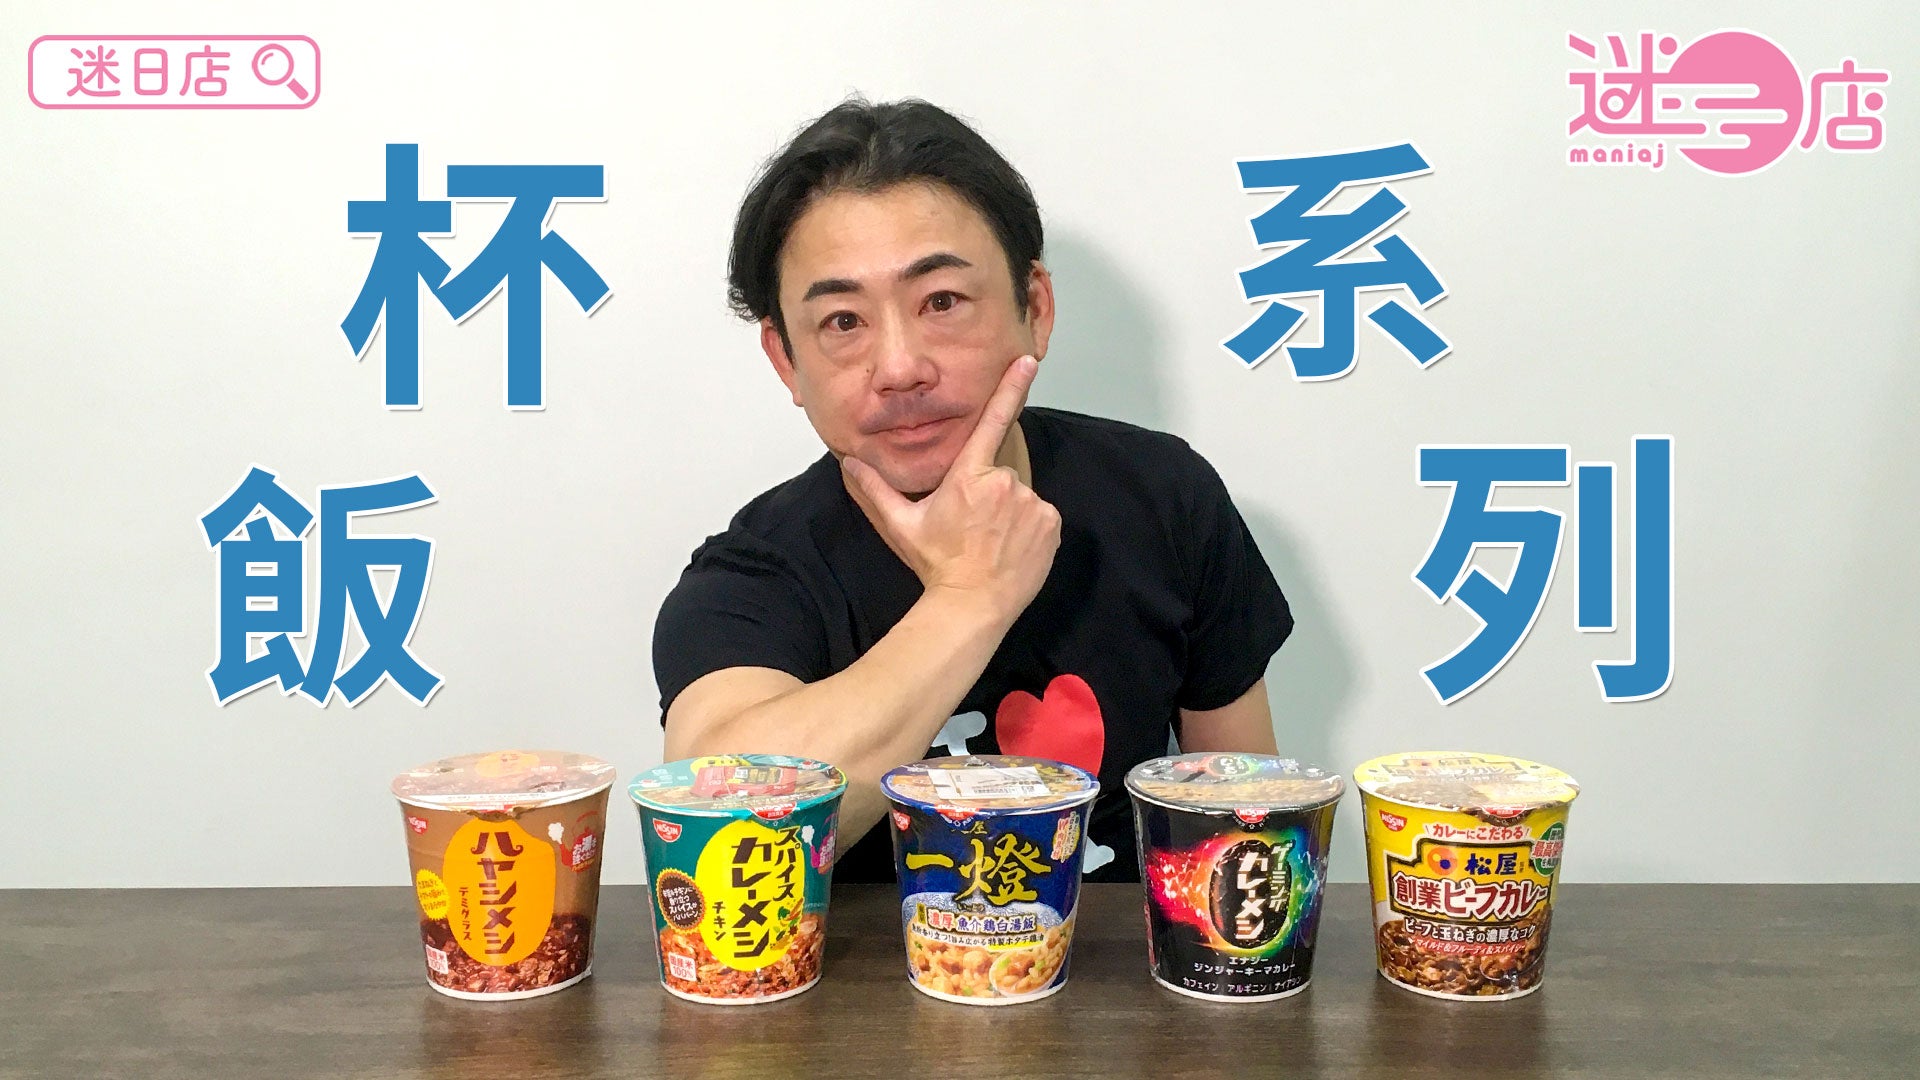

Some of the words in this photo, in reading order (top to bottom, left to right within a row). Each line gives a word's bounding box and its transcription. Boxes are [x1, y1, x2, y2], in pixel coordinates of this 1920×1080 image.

[656, 822, 679, 836] NISSIN
[1381, 813, 1405, 828] NISSIN
[1433, 824, 1524, 841] カレーにこだわる
[772, 827, 801, 902] スパイス
[905, 834, 1052, 907] 一燈
[1269, 842, 1293, 912] ゲーミング
[1465, 853, 1518, 876] 松屋
[470, 831, 524, 954] ハヤシメシ
[731, 836, 772, 958] カレーメシ
[1235, 851, 1269, 940] カレーメシ
[1396, 875, 1547, 916] 創業ビーフカレー
[459, 887, 472, 941] デミグラス
[712, 901, 726, 941] チキン
[1405, 918, 1537, 943] ビーフと玉ねぎの濃厚なコク
[1194, 962, 1296, 976] ジンジャーキーマカレー
[1229, 956, 1269, 965] エナジー
[1182, 977, 1219, 992] カフェイン
[1228, 983, 1267, 994] アルギニン
